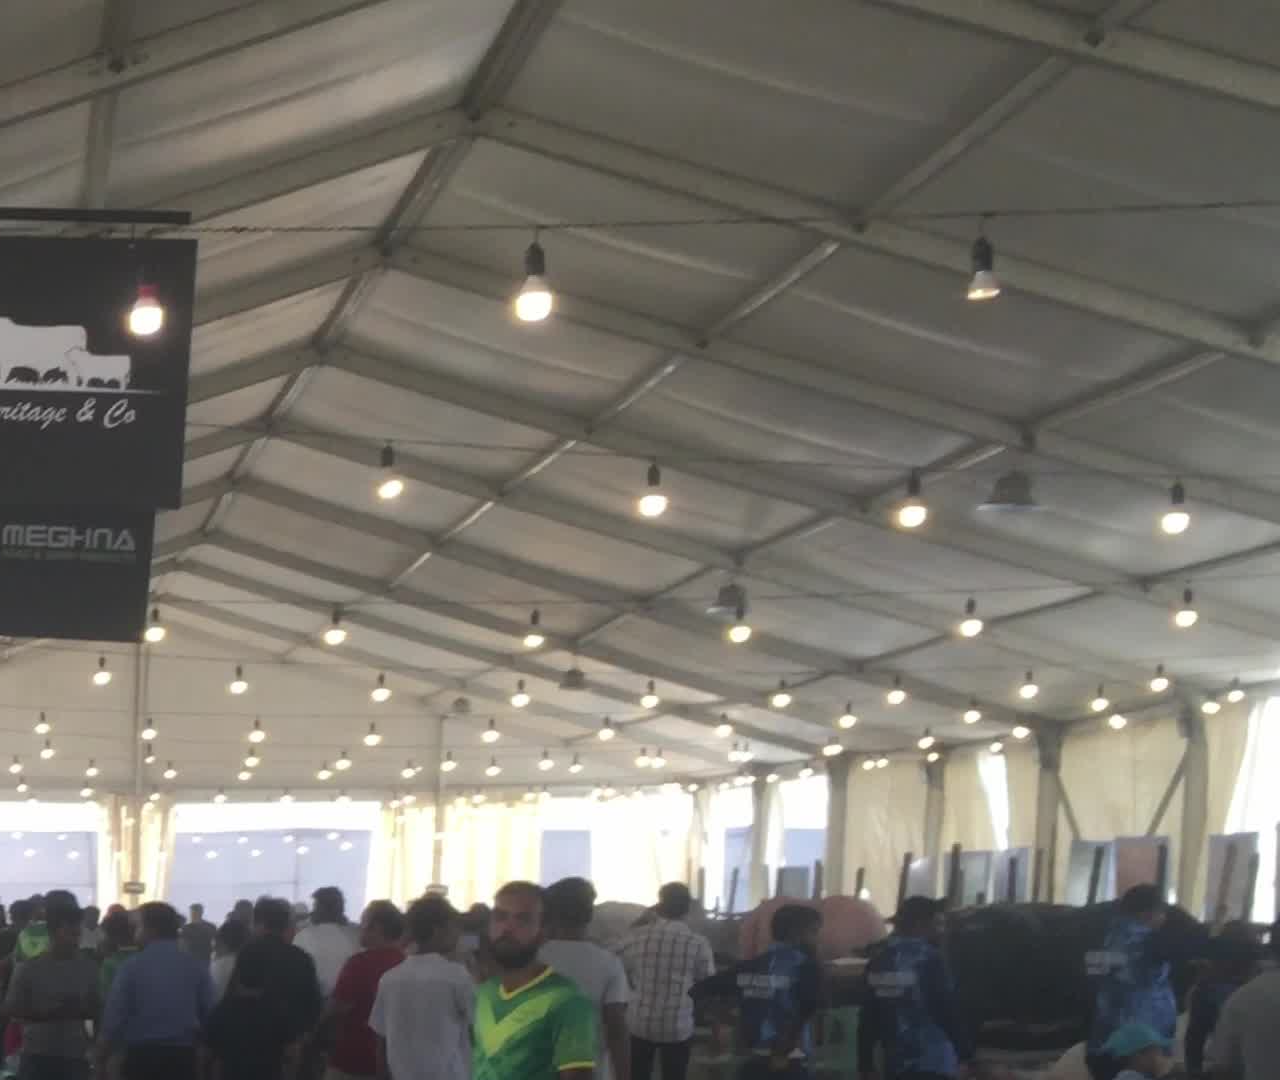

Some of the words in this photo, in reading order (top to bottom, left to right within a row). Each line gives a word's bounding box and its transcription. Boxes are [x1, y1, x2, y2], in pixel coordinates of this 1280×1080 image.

[75, 398, 97, 423] &
[103, 398, 137, 429] Co
[2, 523, 136, 551] MEGHNA
